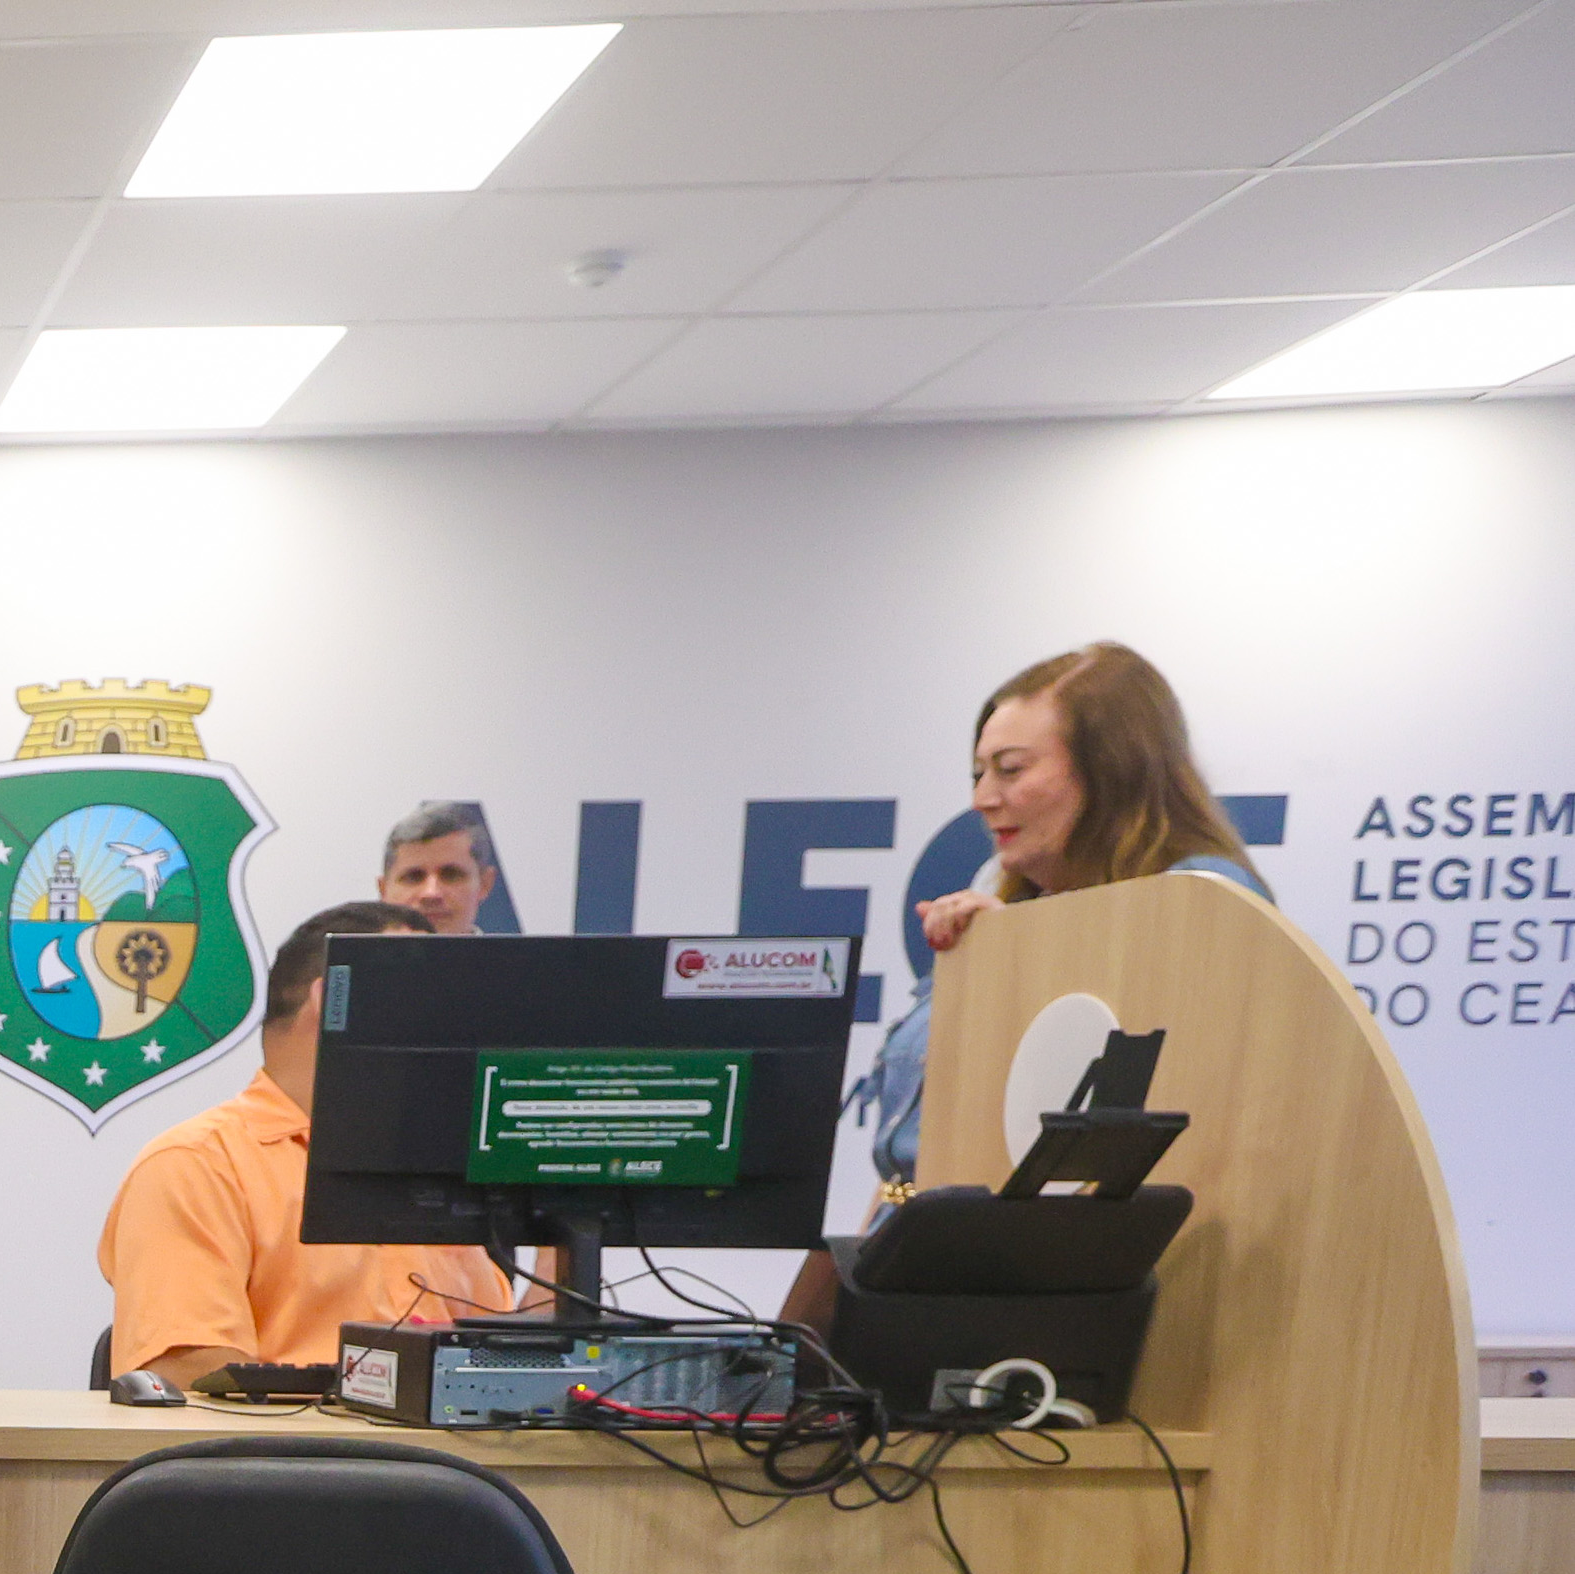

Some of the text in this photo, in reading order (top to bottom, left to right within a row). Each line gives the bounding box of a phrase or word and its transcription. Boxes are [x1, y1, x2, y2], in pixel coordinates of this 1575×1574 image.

[1355, 793, 1575, 839] ASSEM
[725, 952, 816, 968] ALUCOM
[1348, 920, 1436, 964] DO
